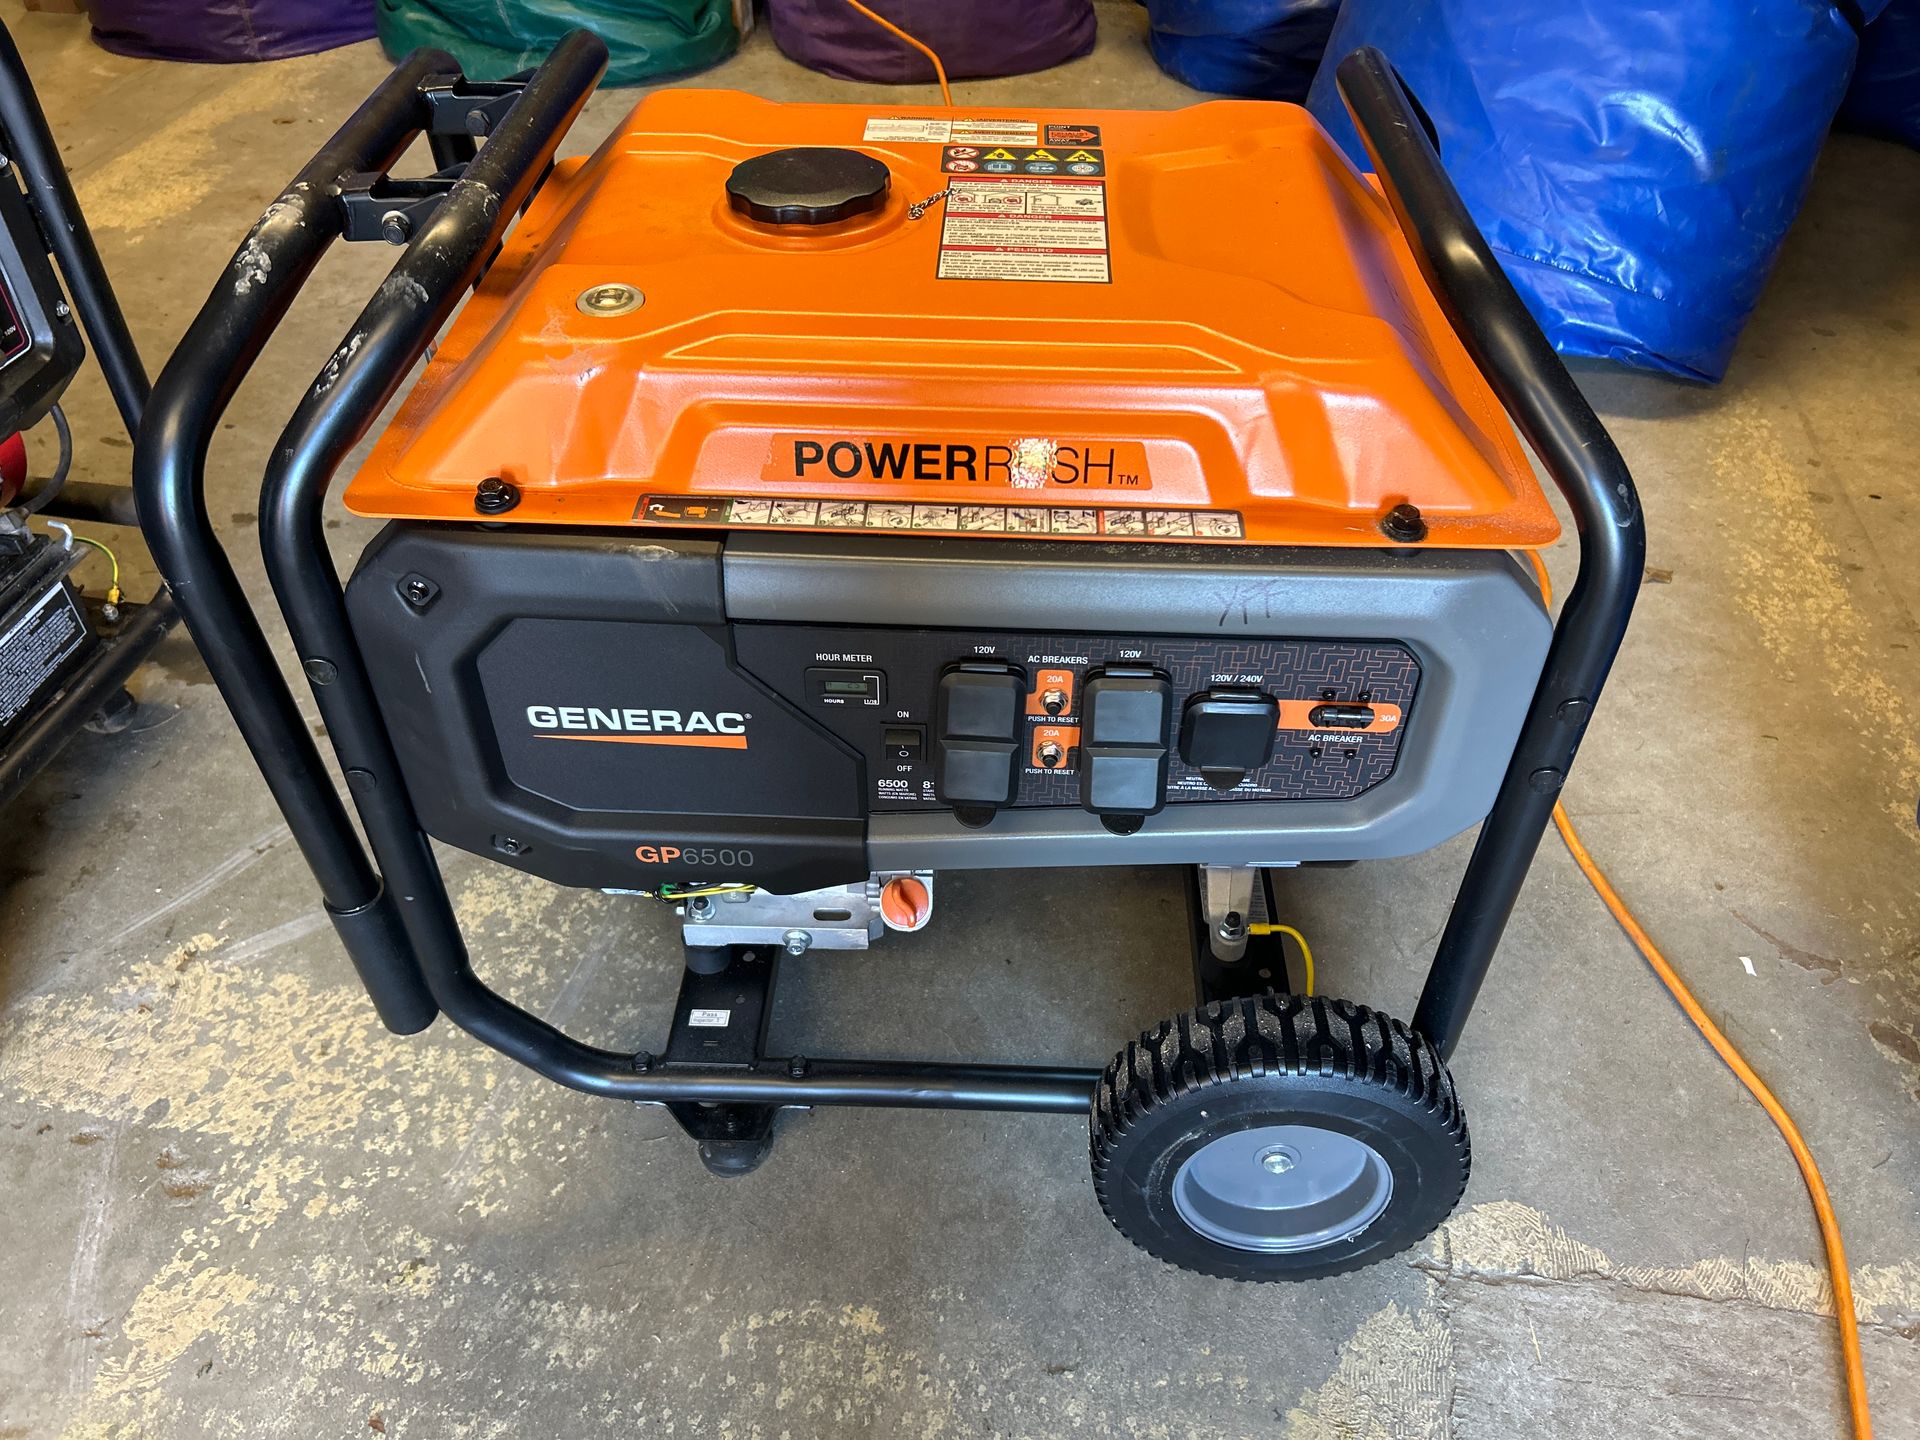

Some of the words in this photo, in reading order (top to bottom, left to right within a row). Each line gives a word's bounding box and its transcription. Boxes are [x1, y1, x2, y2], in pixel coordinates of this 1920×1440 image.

[973, 646, 996, 654] 120V
[1119, 649, 1142, 659] 120V
[815, 653, 841, 661] HOUR
[842, 654, 873, 663] METER
[1027, 655, 1040, 663] AC
[1042, 656, 1089, 665] BREAKERS
[1046, 675, 1064, 683] 20A
[1210, 674, 1233, 682] 120V
[1239, 675, 1264, 683] 240V
[896, 710, 910, 718] ON
[1378, 714, 1397, 723] 30A
[1043, 729, 1060, 737] 20A
[1308, 734, 1320, 742] AC
[1322, 735, 1363, 744] BREAKER
[877, 779, 909, 788] 6500
[635, 845, 754, 867] GP6500
